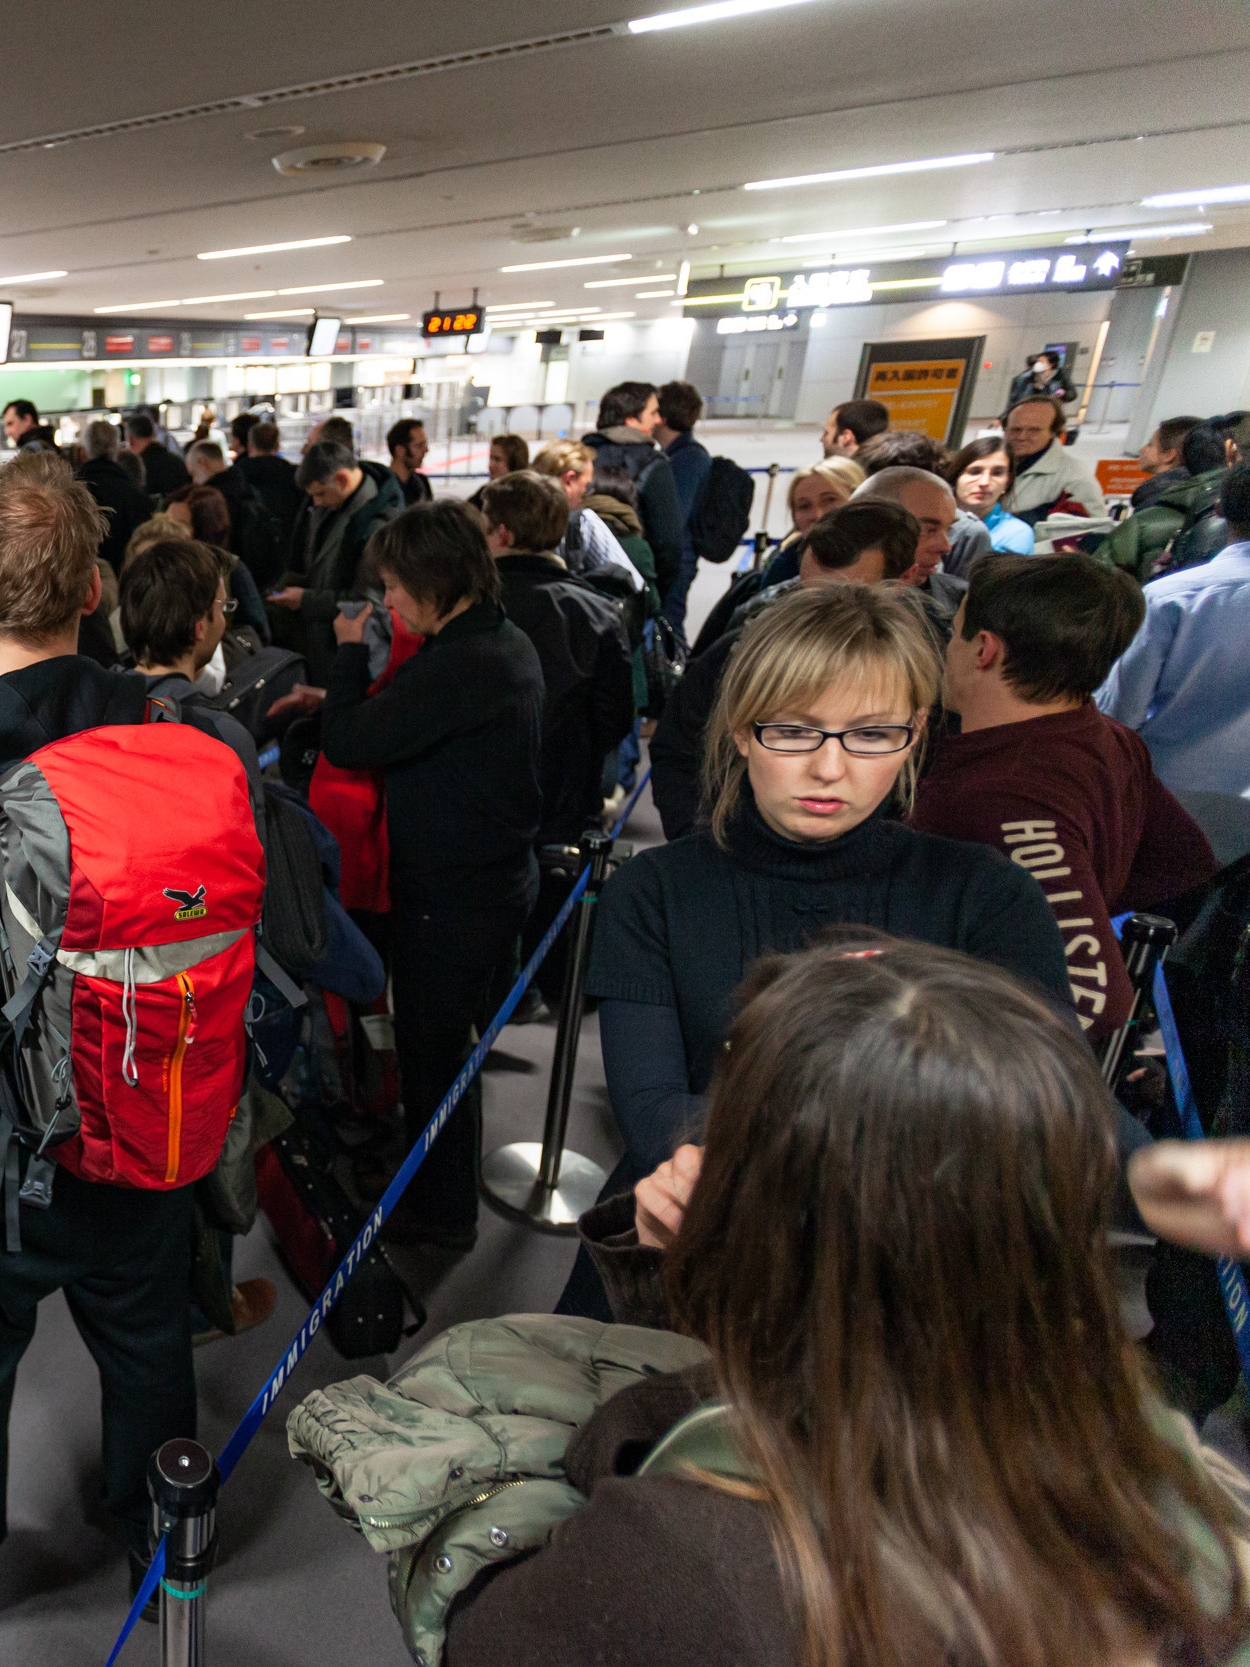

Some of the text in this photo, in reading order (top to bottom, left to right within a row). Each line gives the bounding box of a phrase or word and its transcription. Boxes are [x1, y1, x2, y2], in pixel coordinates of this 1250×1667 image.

[178, 908, 205, 919] SALEWA
[1001, 820, 1107, 1030] HOISTE
[261, 1205, 383, 1415] IMMIGRATION
